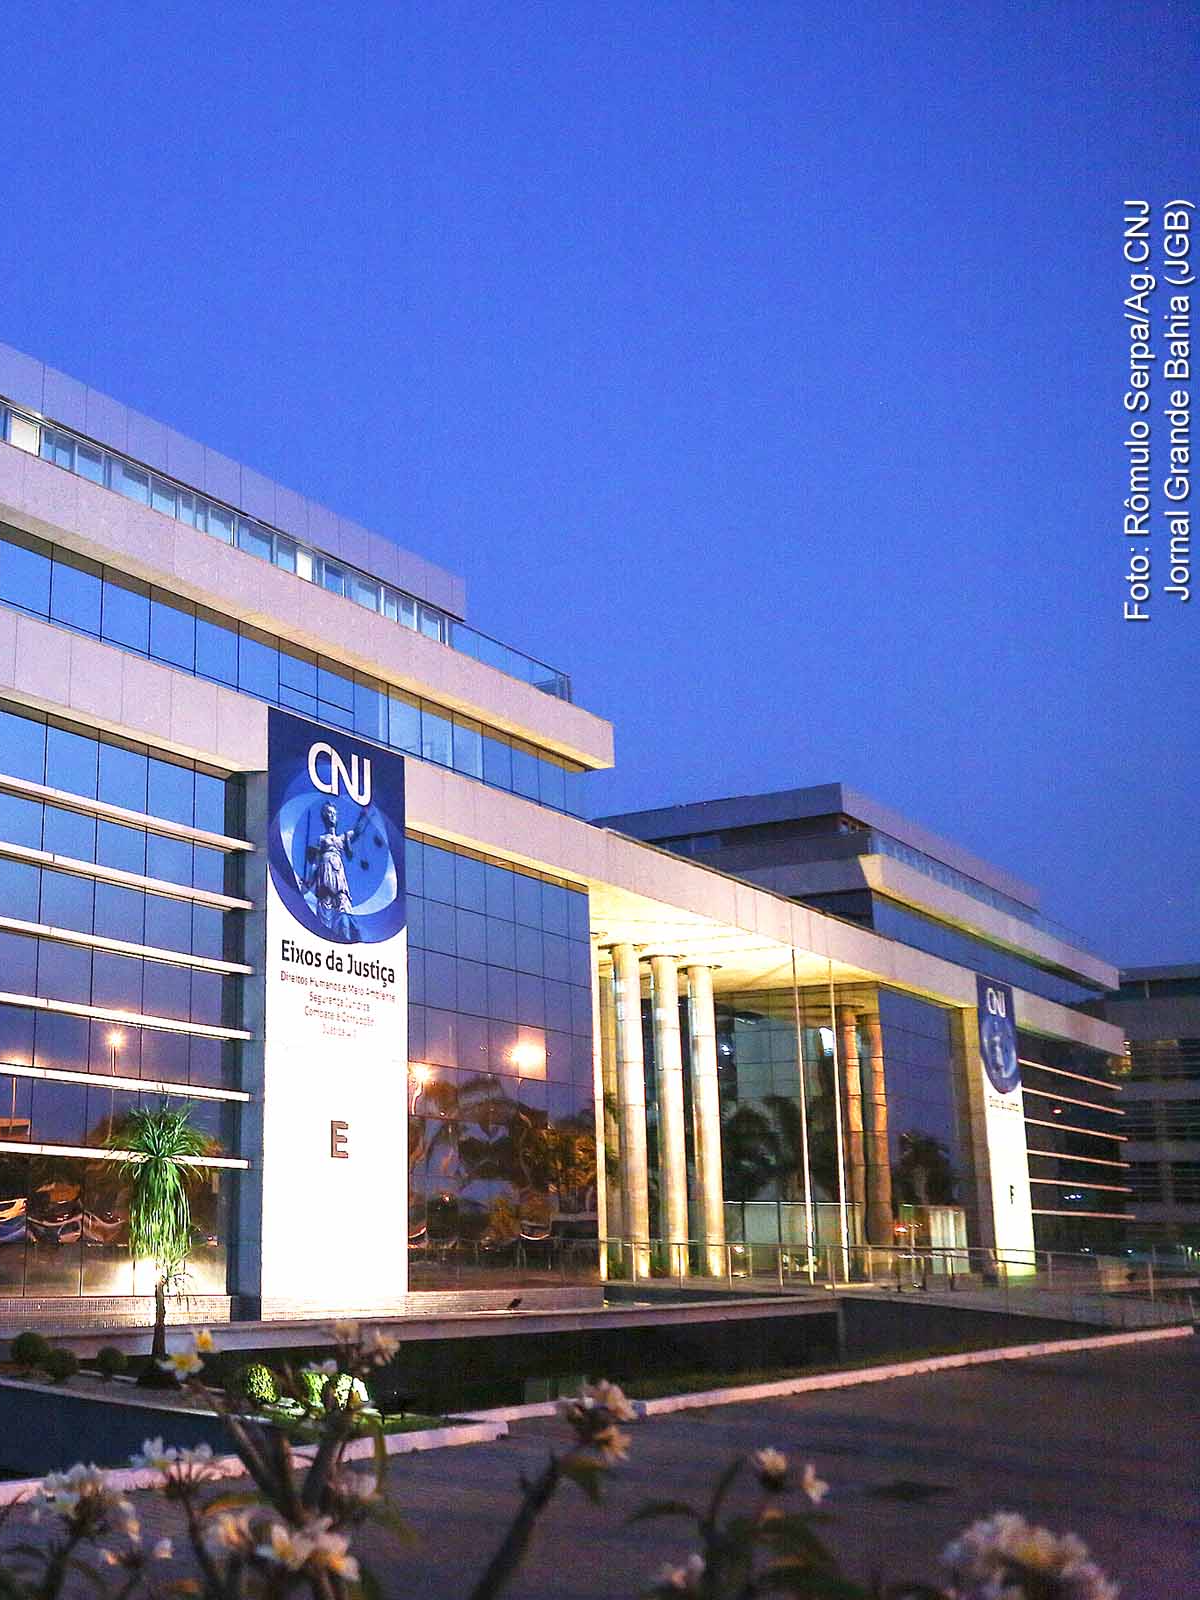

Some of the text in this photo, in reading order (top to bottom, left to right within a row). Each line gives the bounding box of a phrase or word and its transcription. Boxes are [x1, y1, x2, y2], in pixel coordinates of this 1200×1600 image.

[307, 741, 372, 807] CNJ
[281, 939, 395, 988] Eixos da Justiça
[331, 1120, 348, 1159] E
